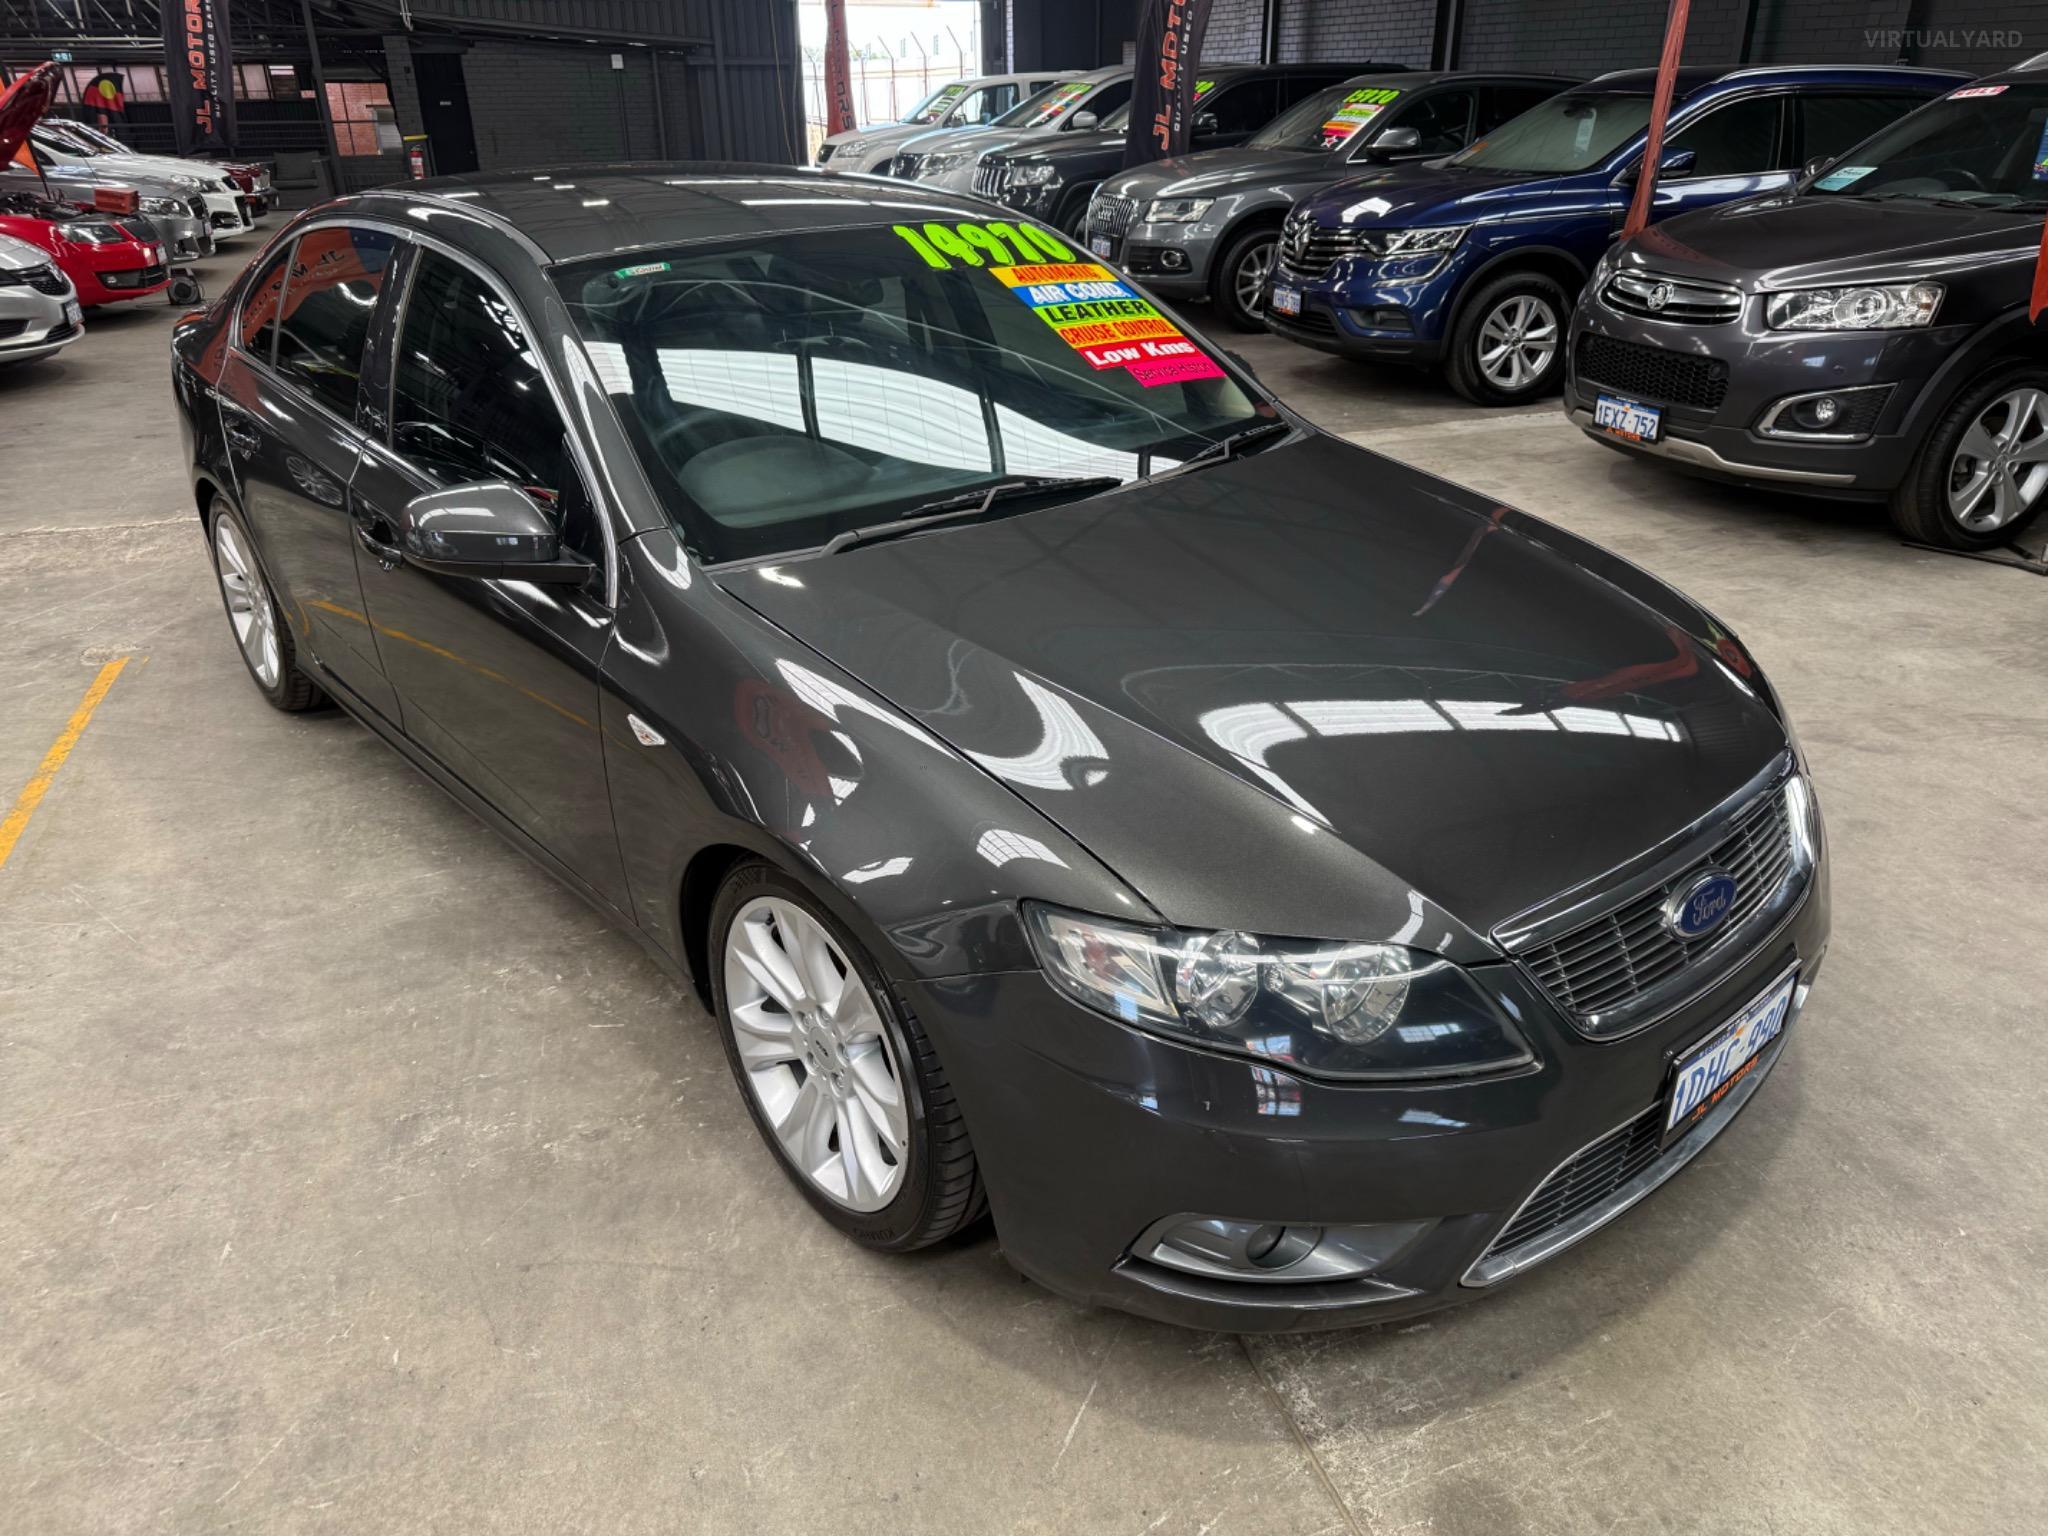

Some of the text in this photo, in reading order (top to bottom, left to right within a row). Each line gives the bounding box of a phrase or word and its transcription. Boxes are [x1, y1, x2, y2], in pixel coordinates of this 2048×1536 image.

[1180, 10, 1193, 55] USED
[196, 99, 213, 134] JL
[1153, 104, 1171, 151] JL
[893, 221, 1077, 270] 14970
[1010, 264, 1099, 282] AUTOMATIC
[1031, 284, 1067, 305] AIR
[1046, 300, 1149, 323] LEATHER
[1060, 318, 1175, 348] CRUISE CONTROL
[1084, 338, 1197, 367] Low Kms
[1692, 888, 1727, 927] Ford
[1711, 1053, 1760, 1103] MOTORS
